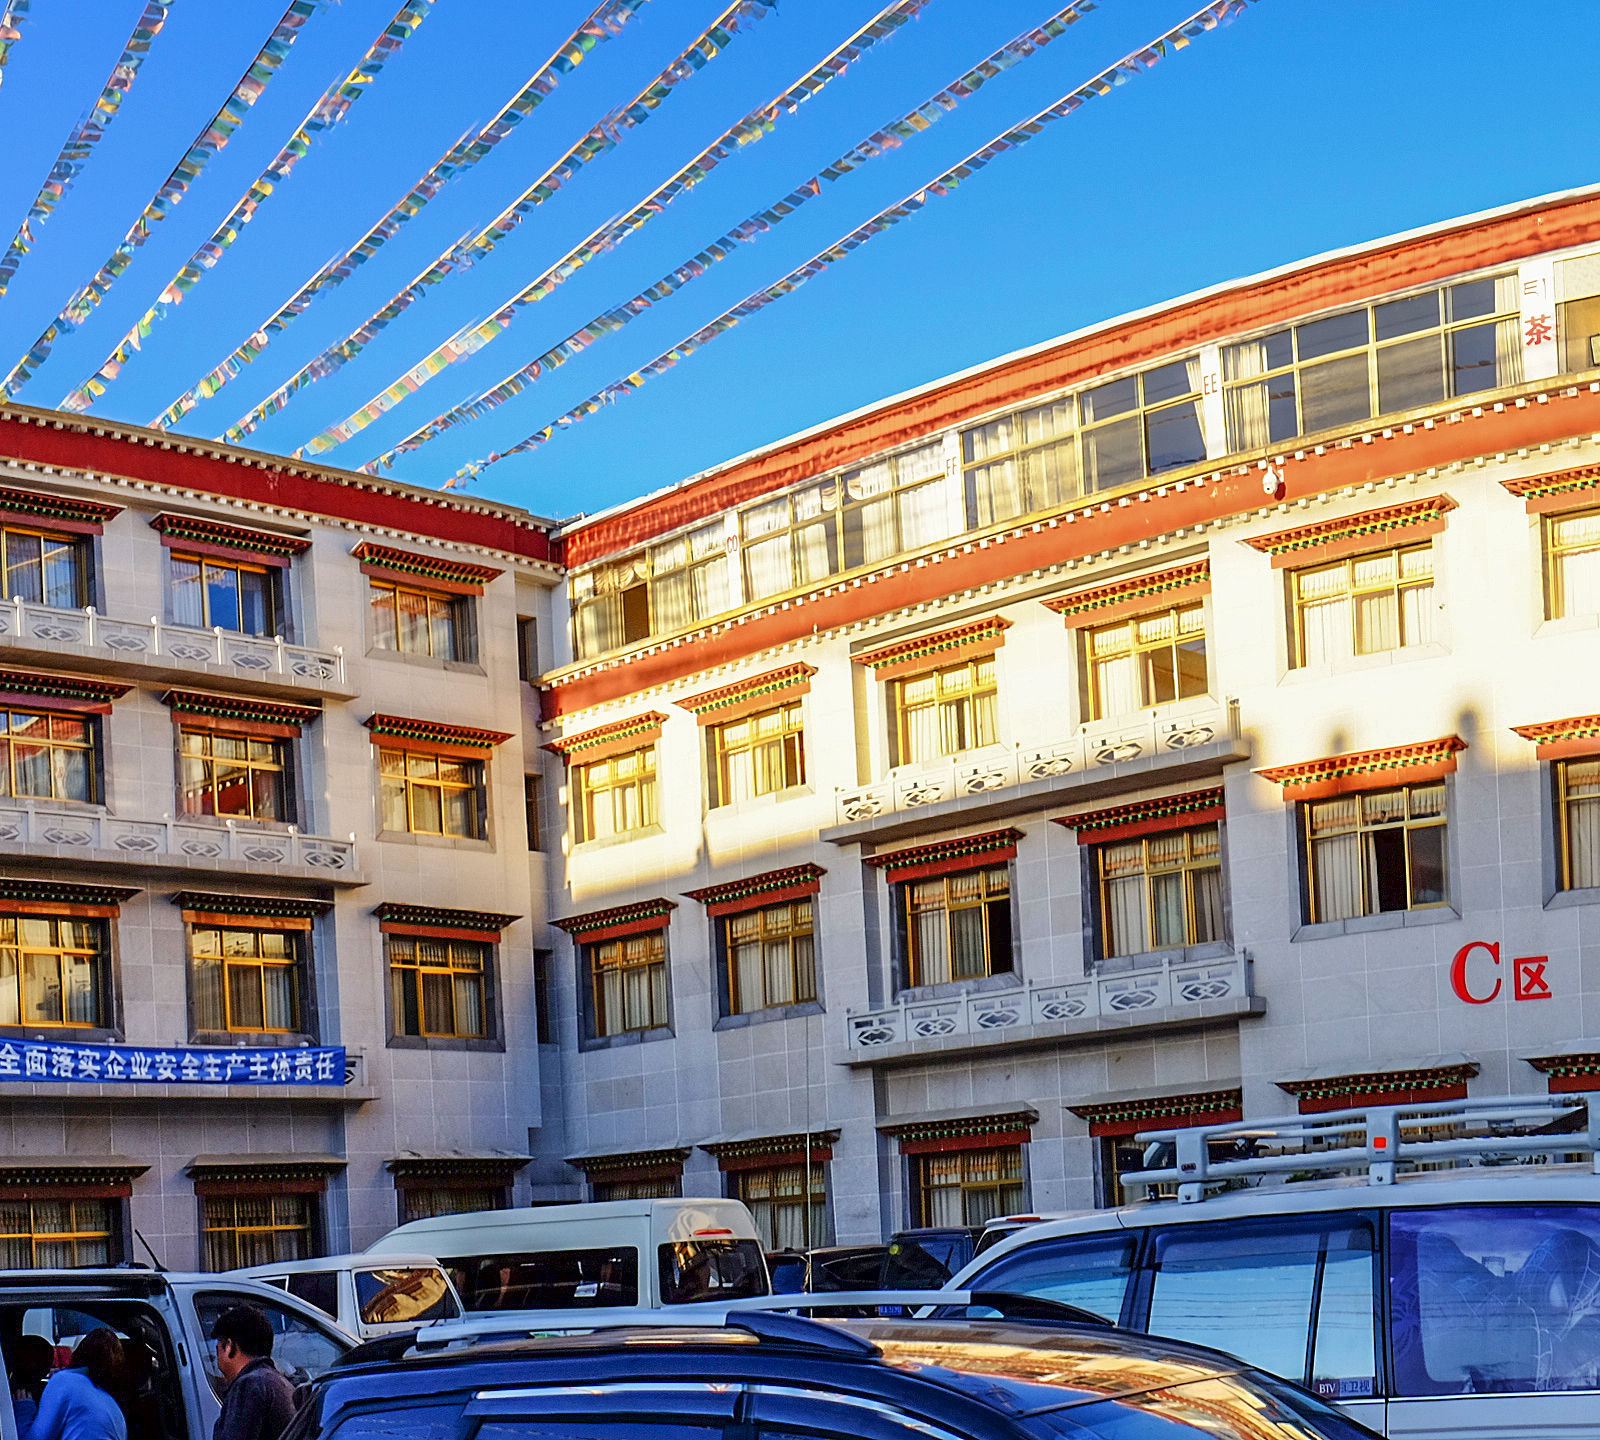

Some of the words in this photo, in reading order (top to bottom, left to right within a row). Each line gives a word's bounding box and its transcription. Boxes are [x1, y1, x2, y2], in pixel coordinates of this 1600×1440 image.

[1524, 314, 1552, 346] 茶
[1203, 372, 1218, 395] EE
[1319, 1383, 1336, 1394] BTV
